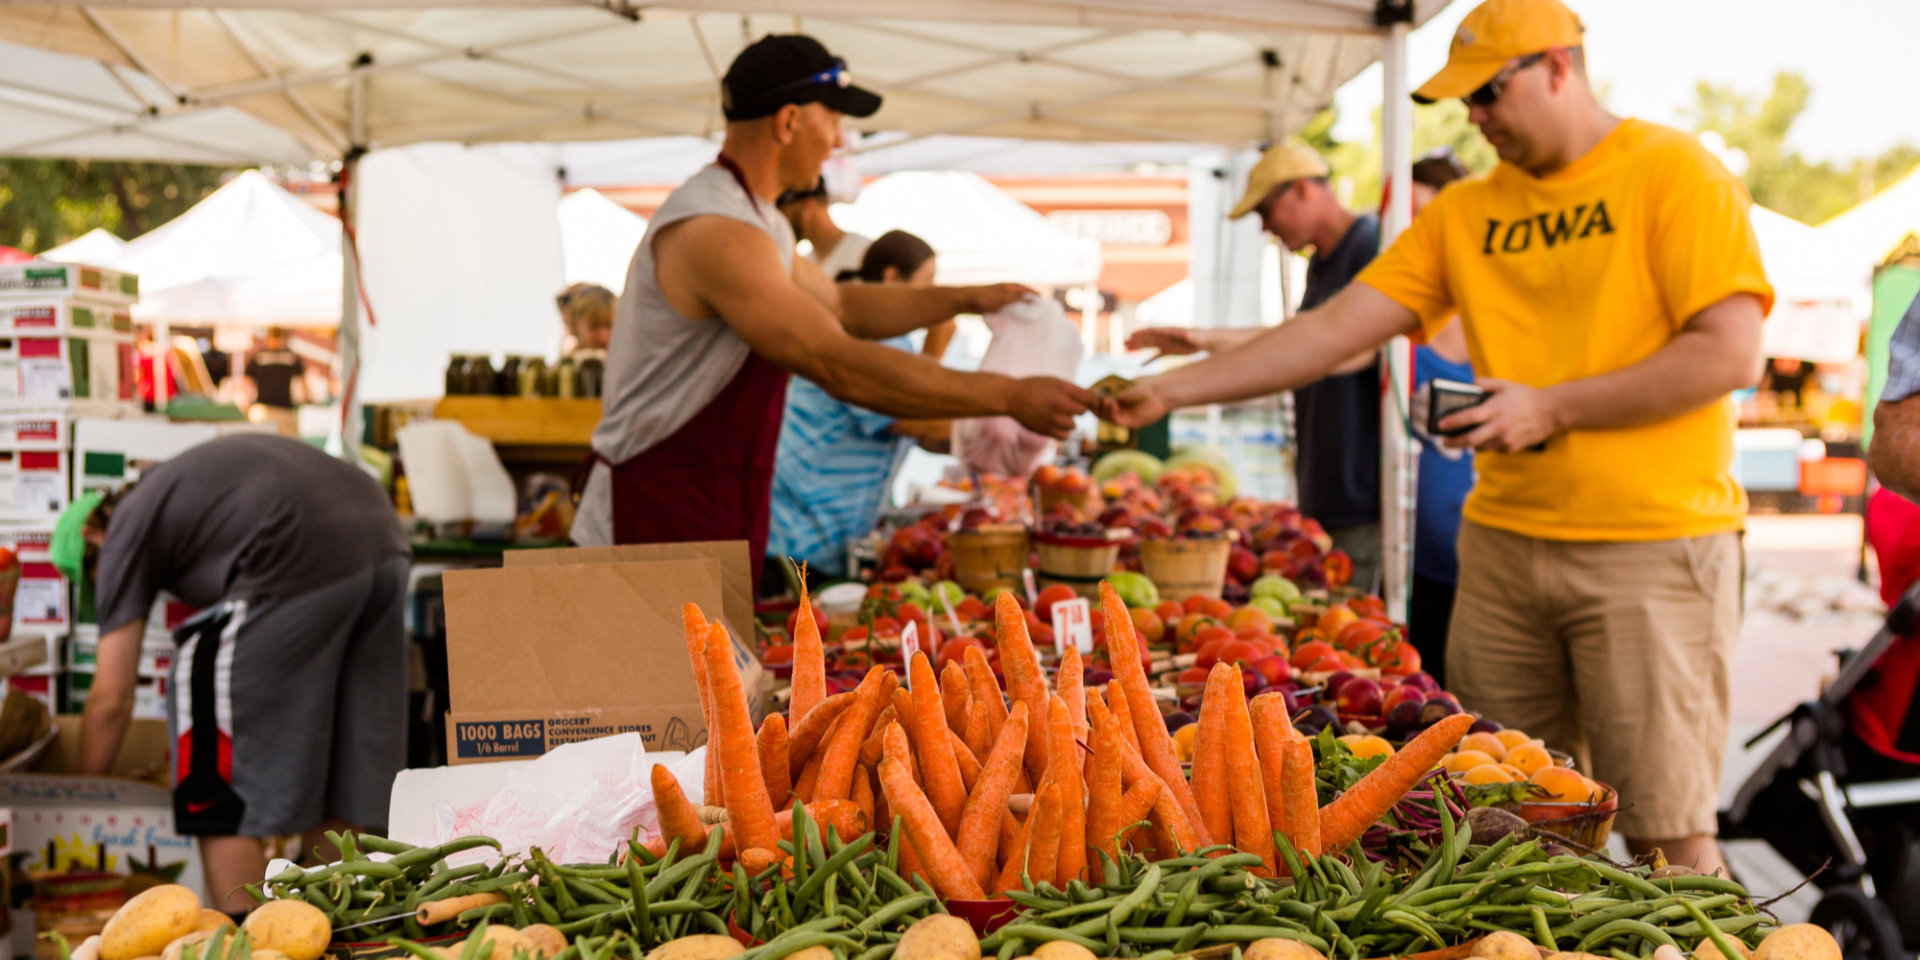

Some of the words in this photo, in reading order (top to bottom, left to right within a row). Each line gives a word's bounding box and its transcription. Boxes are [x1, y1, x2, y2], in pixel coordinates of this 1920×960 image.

[1483, 200, 1615, 255] IOWA
[548, 718, 591, 727] GROCERY
[460, 724, 497, 742] 1000
[502, 723, 542, 740] BAGS
[548, 726, 614, 736] CONVENIENCE
[618, 724, 652, 733] STORES
[477, 742, 492, 756] 1/6
[493, 740, 520, 753] Barrel
[549, 737, 600, 746] RESTAUR
